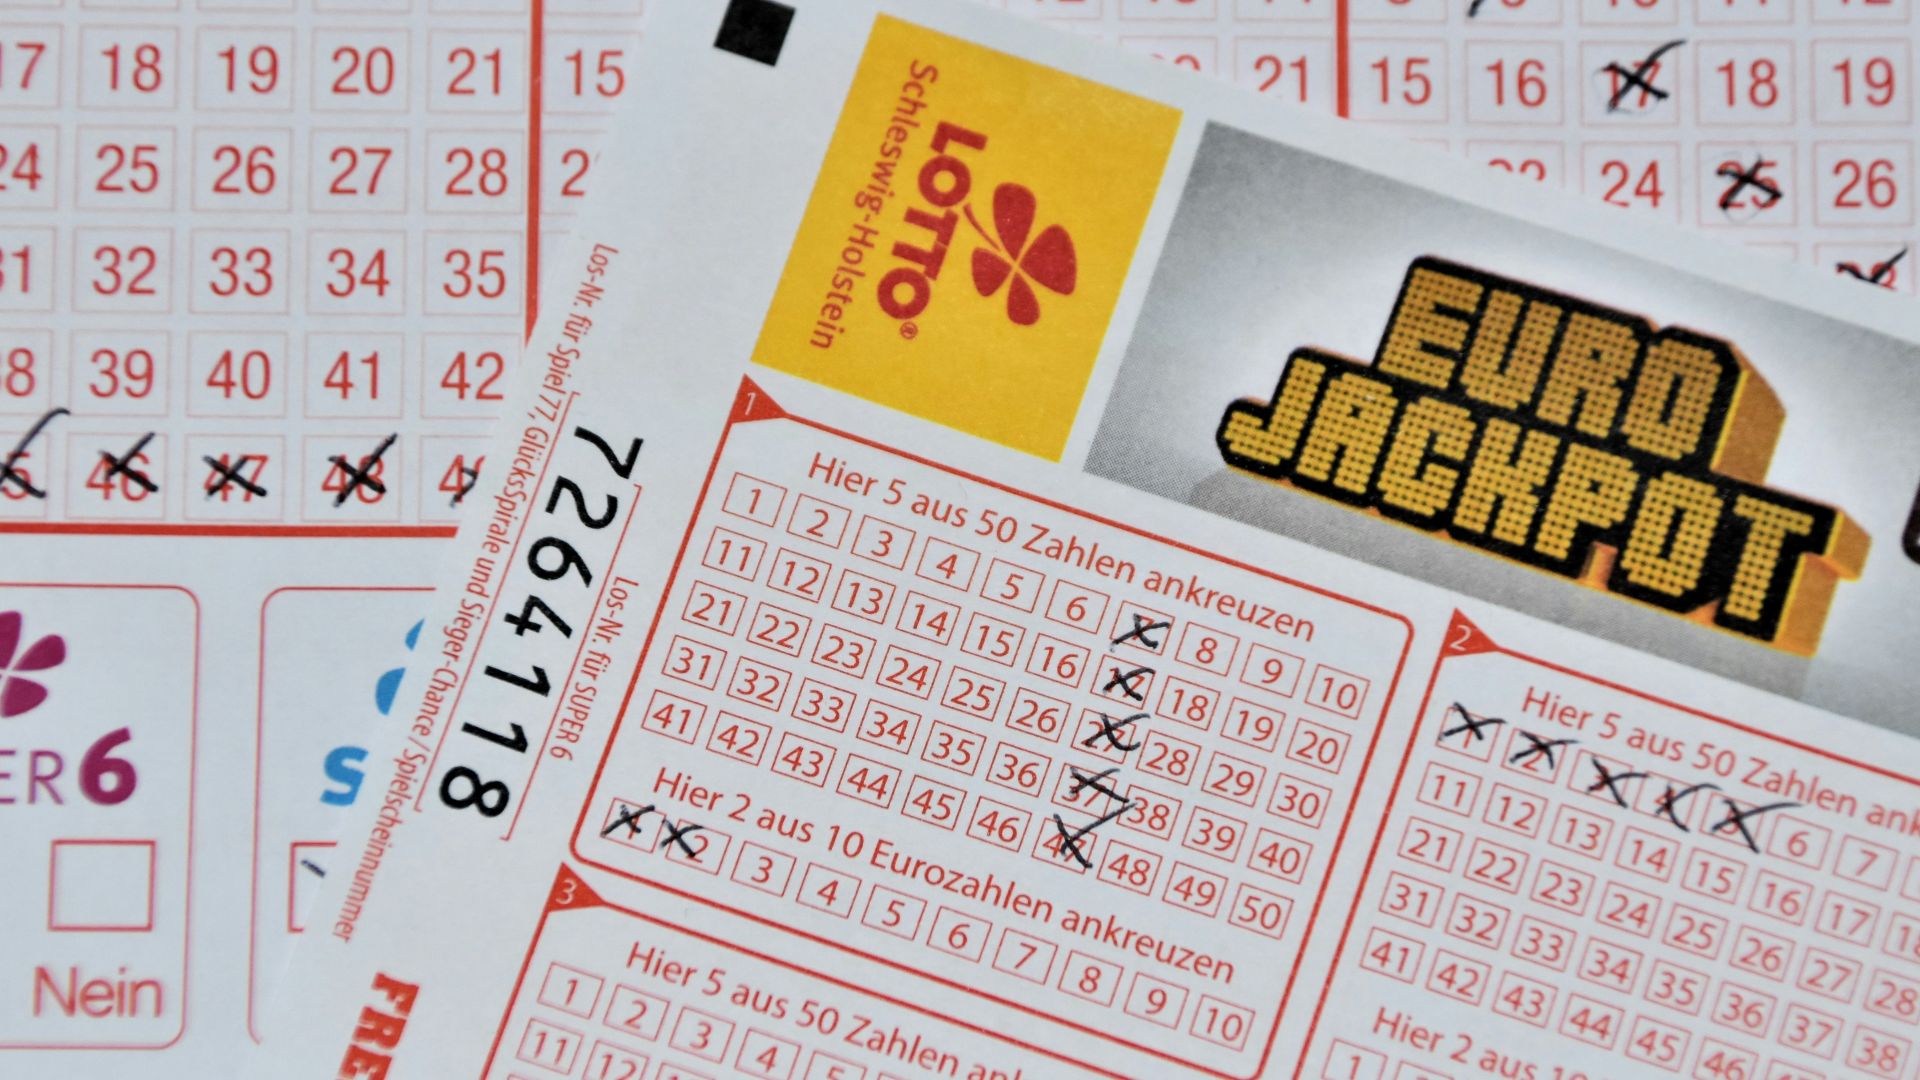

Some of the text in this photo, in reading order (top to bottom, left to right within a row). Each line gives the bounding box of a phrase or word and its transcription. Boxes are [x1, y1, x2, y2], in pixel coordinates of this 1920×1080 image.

[102, 43, 502, 96] 18 19 20 21
[566, 49, 626, 98] 15
[1371, 57, 1896, 108] 15 16 18 19
[95, 143, 509, 197] 25 26 27 28
[810, 58, 938, 350] Schleswig-Holstein
[1600, 159, 1664, 209] 24
[1833, 159, 1897, 209] 26
[92, 245, 507, 299] 32 33 34 35
[573, 243, 619, 308] Los-Nr.
[547, 343, 581, 395] Spiel
[562, 312, 593, 344] für
[1377, 266, 1728, 461] EURO
[90, 348, 505, 401] 39 40 41 42
[743, 391, 756, 416] 1
[482, 426, 550, 554] GlücksSpirale
[1220, 356, 1814, 622] JACKPOT
[466, 554, 496, 598] und
[808, 452, 1316, 643] Hier 5 aus 50 Zahlen ankreuzen
[748, 487, 1359, 711] 1 2 3 4 5 6 8 9 10
[1450, 624, 1472, 651] 2
[549, 575, 639, 761] Los-Nr. für SUPER 6
[719, 539, 1340, 766] 11 12 13 14 15 16 18 19 20
[691, 591, 1321, 820] 21 22 23 24 25 26 28 29 30
[78, 726, 137, 806] 6
[672, 646, 1302, 875] 31 32 33 34 35 36 38 39 40
[1521, 686, 1859, 819] Hier 5 aus 50 Zahlen
[332, 747, 428, 944] Spielscheinnummer
[653, 703, 1282, 930] 41 42 43 44 45 46 48 49 50
[1434, 775, 1799, 916] 11 12 13 14 15 16
[1787, 831, 1878, 876] 6 7
[555, 879, 578, 904] 3
[653, 767, 1235, 983] Hier 2 aus 10 Eurozahlen ankreuzen
[1407, 828, 1715, 950] 21 22 23 24 25
[751, 855, 1244, 1041] 3 4 5 6 7 8 9 10
[1390, 882, 1630, 982] 31 32 33 34
[33, 965, 164, 1018] Nein
[625, 941, 960, 1077] Hier 5 aus 50 Zahlen
[1372, 941, 1546, 1018] 41 42 43
[535, 1031, 568, 1064] 11
[565, 978, 778, 1072] 1 2 3 4
[1372, 1006, 1473, 1062] Hier 2
